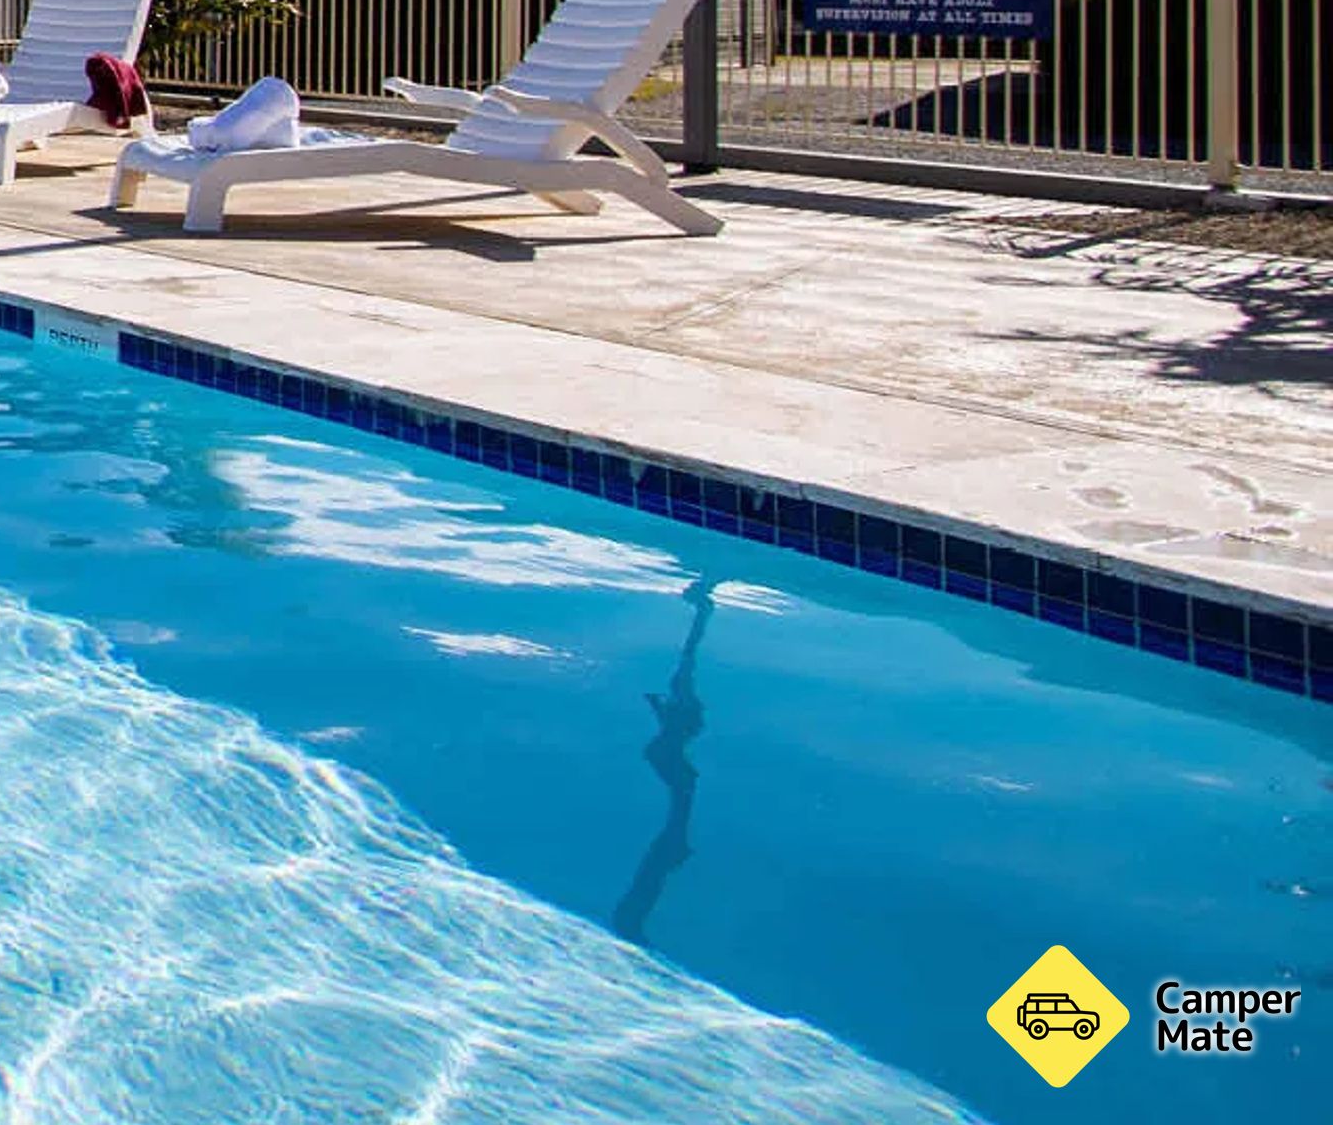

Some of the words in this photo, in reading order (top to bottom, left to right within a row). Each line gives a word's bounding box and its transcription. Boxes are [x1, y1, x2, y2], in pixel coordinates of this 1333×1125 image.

[815, 8, 910, 21] SUPERVISION
[916, 9, 937, 22] AT
[944, 11, 976, 24] ALL
[981, 11, 1034, 25] TIMES
